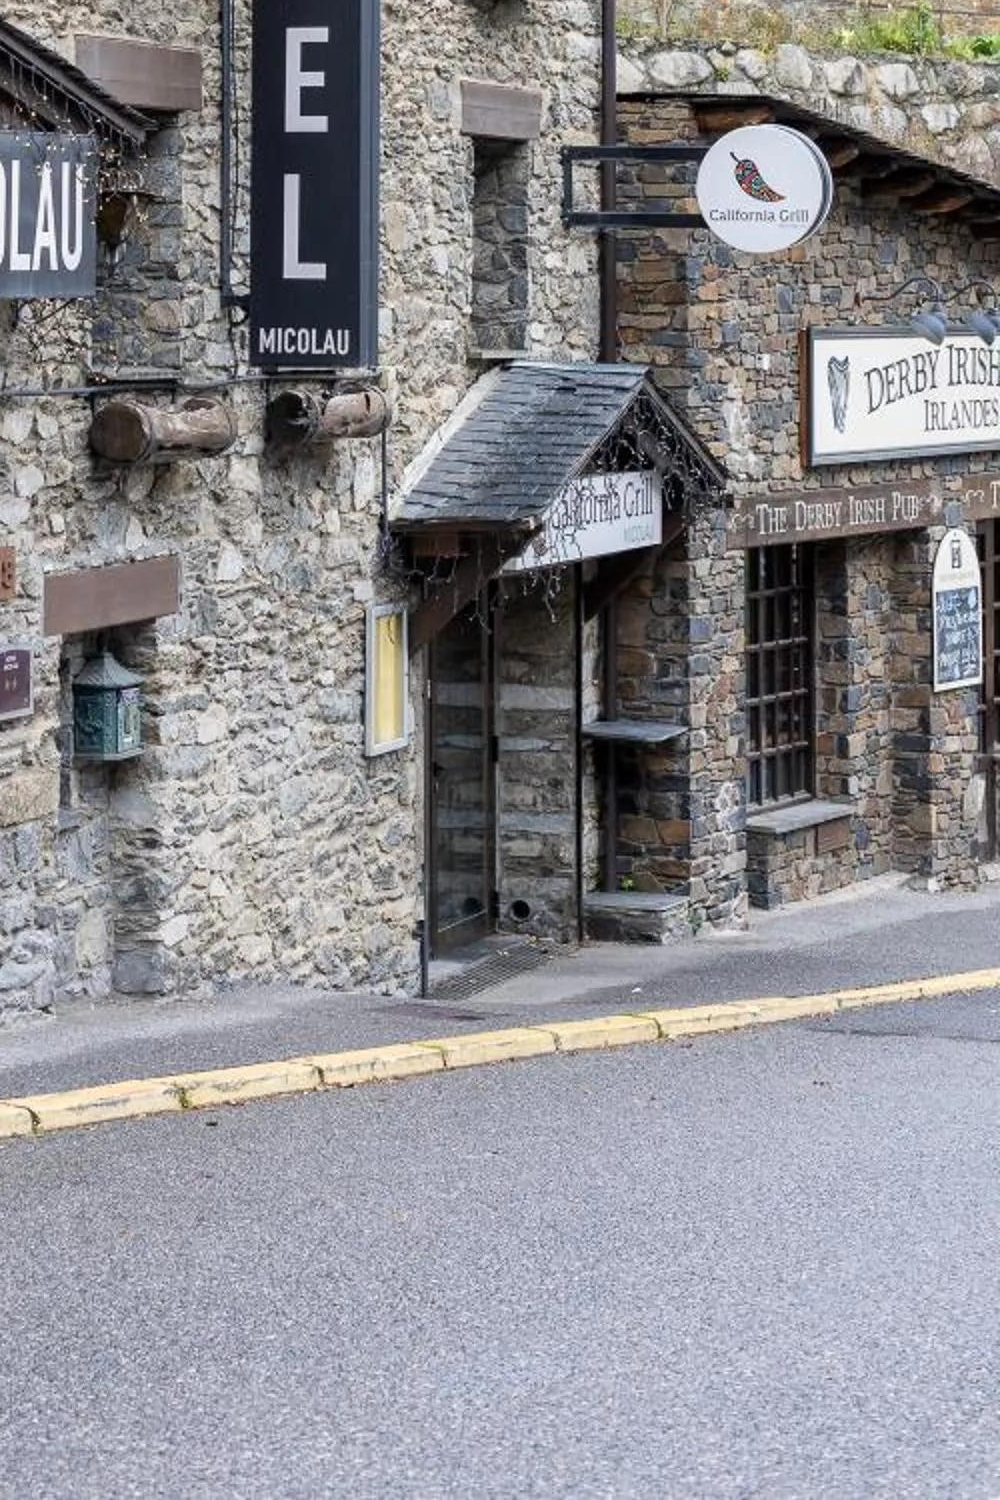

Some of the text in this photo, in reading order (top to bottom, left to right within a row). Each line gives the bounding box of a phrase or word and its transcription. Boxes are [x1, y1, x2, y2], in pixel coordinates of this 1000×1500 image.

[709, 209, 809, 222] California Grill
[259, 328, 350, 355] MICOLAU
[864, 349, 941, 415] DERBY
[623, 477, 653, 517] Grill
[755, 491, 919, 535] THE DERBY IRISH PUB
